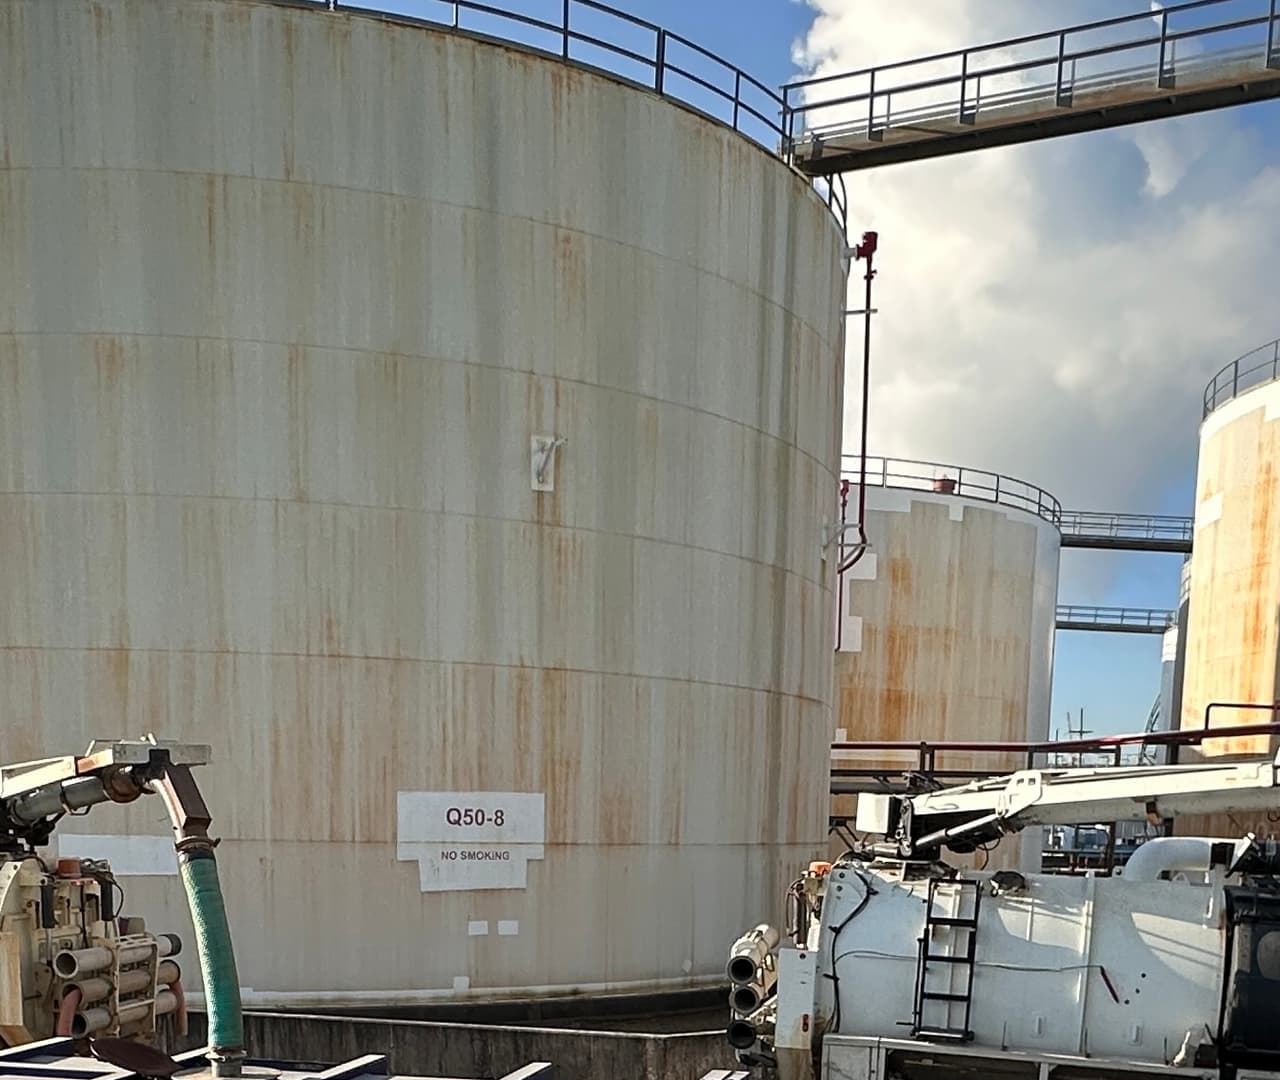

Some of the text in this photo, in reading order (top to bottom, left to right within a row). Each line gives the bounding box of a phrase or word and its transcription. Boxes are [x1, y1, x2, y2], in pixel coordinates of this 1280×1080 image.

[446, 808, 505, 826] Q50-8
[441, 851, 510, 861] NO SMOKING
